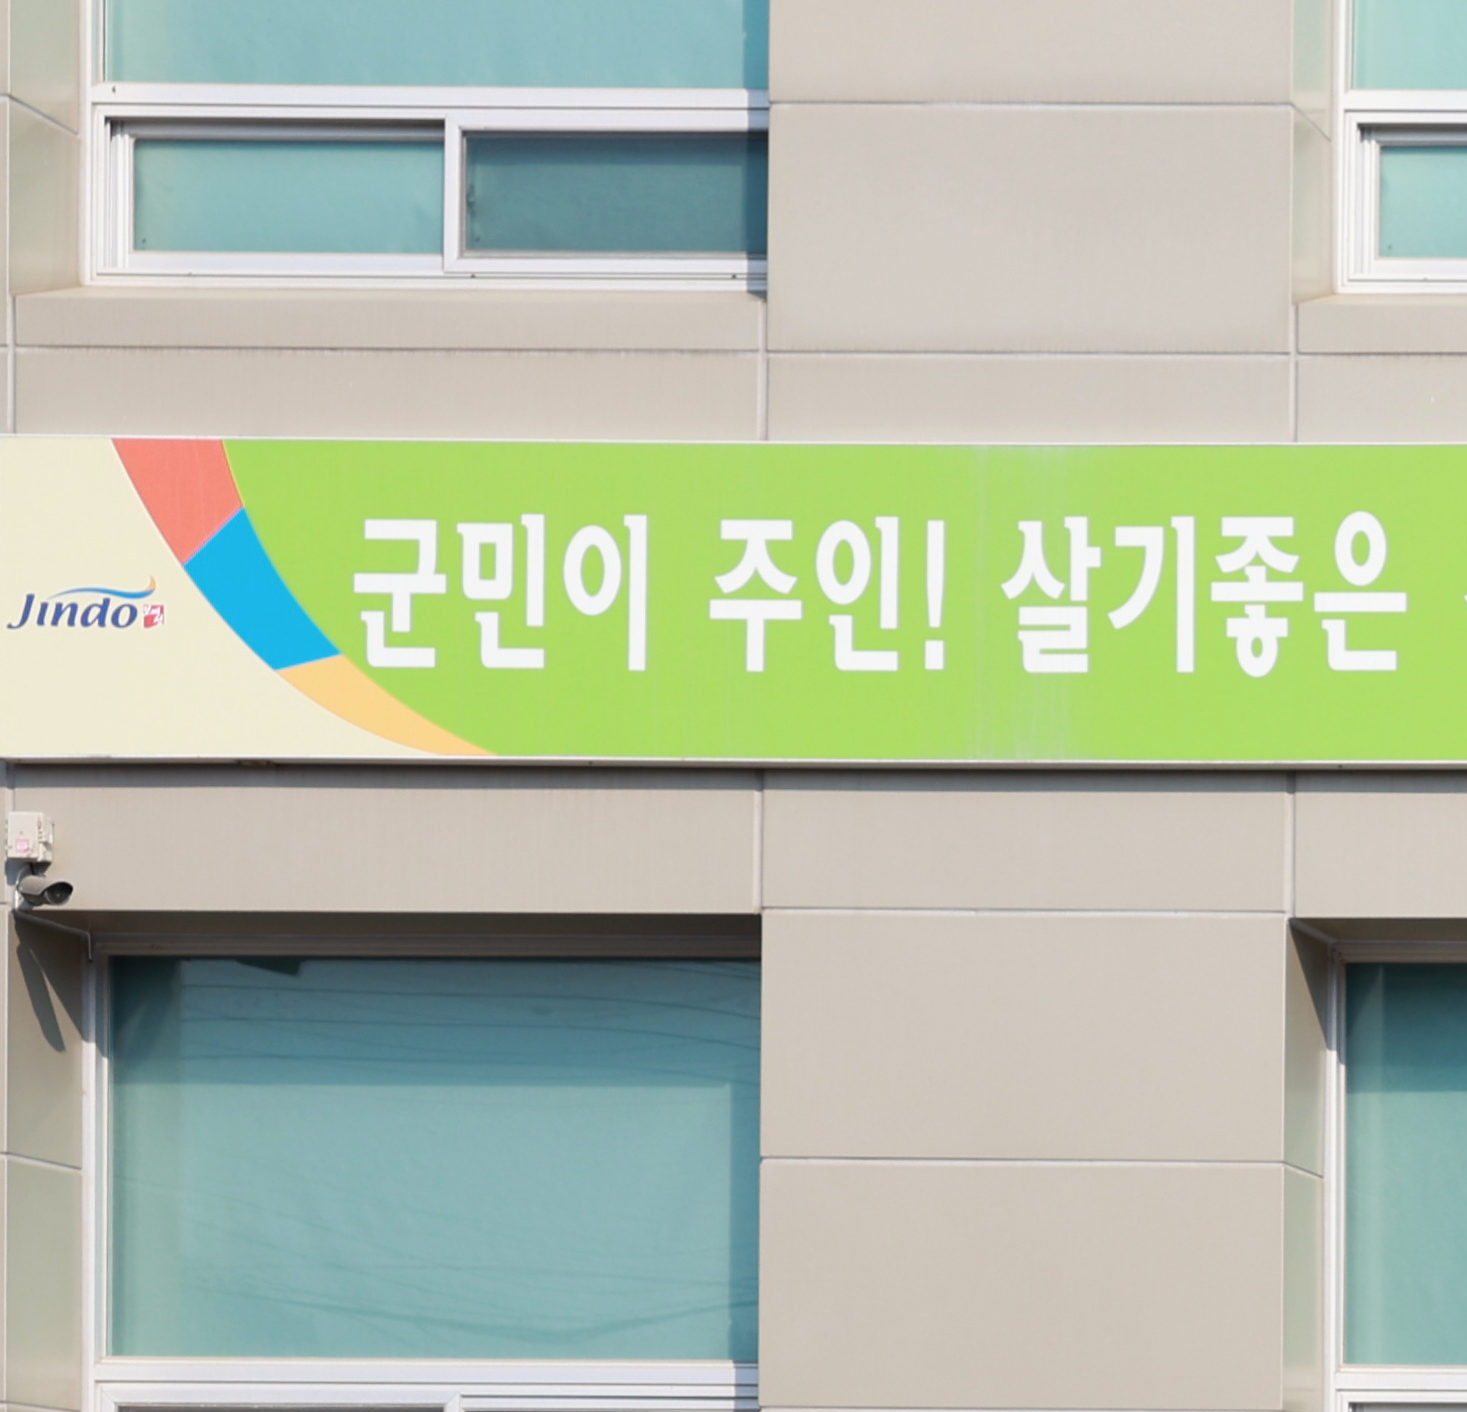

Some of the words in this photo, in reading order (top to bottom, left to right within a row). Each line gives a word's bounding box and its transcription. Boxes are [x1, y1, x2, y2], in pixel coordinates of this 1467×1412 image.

[6, 593, 138, 629] Jindo
[352, 513, 649, 672] 군민이
[708, 515, 946, 673] 주인!
[1000, 510, 1408, 678] 살기좋은
